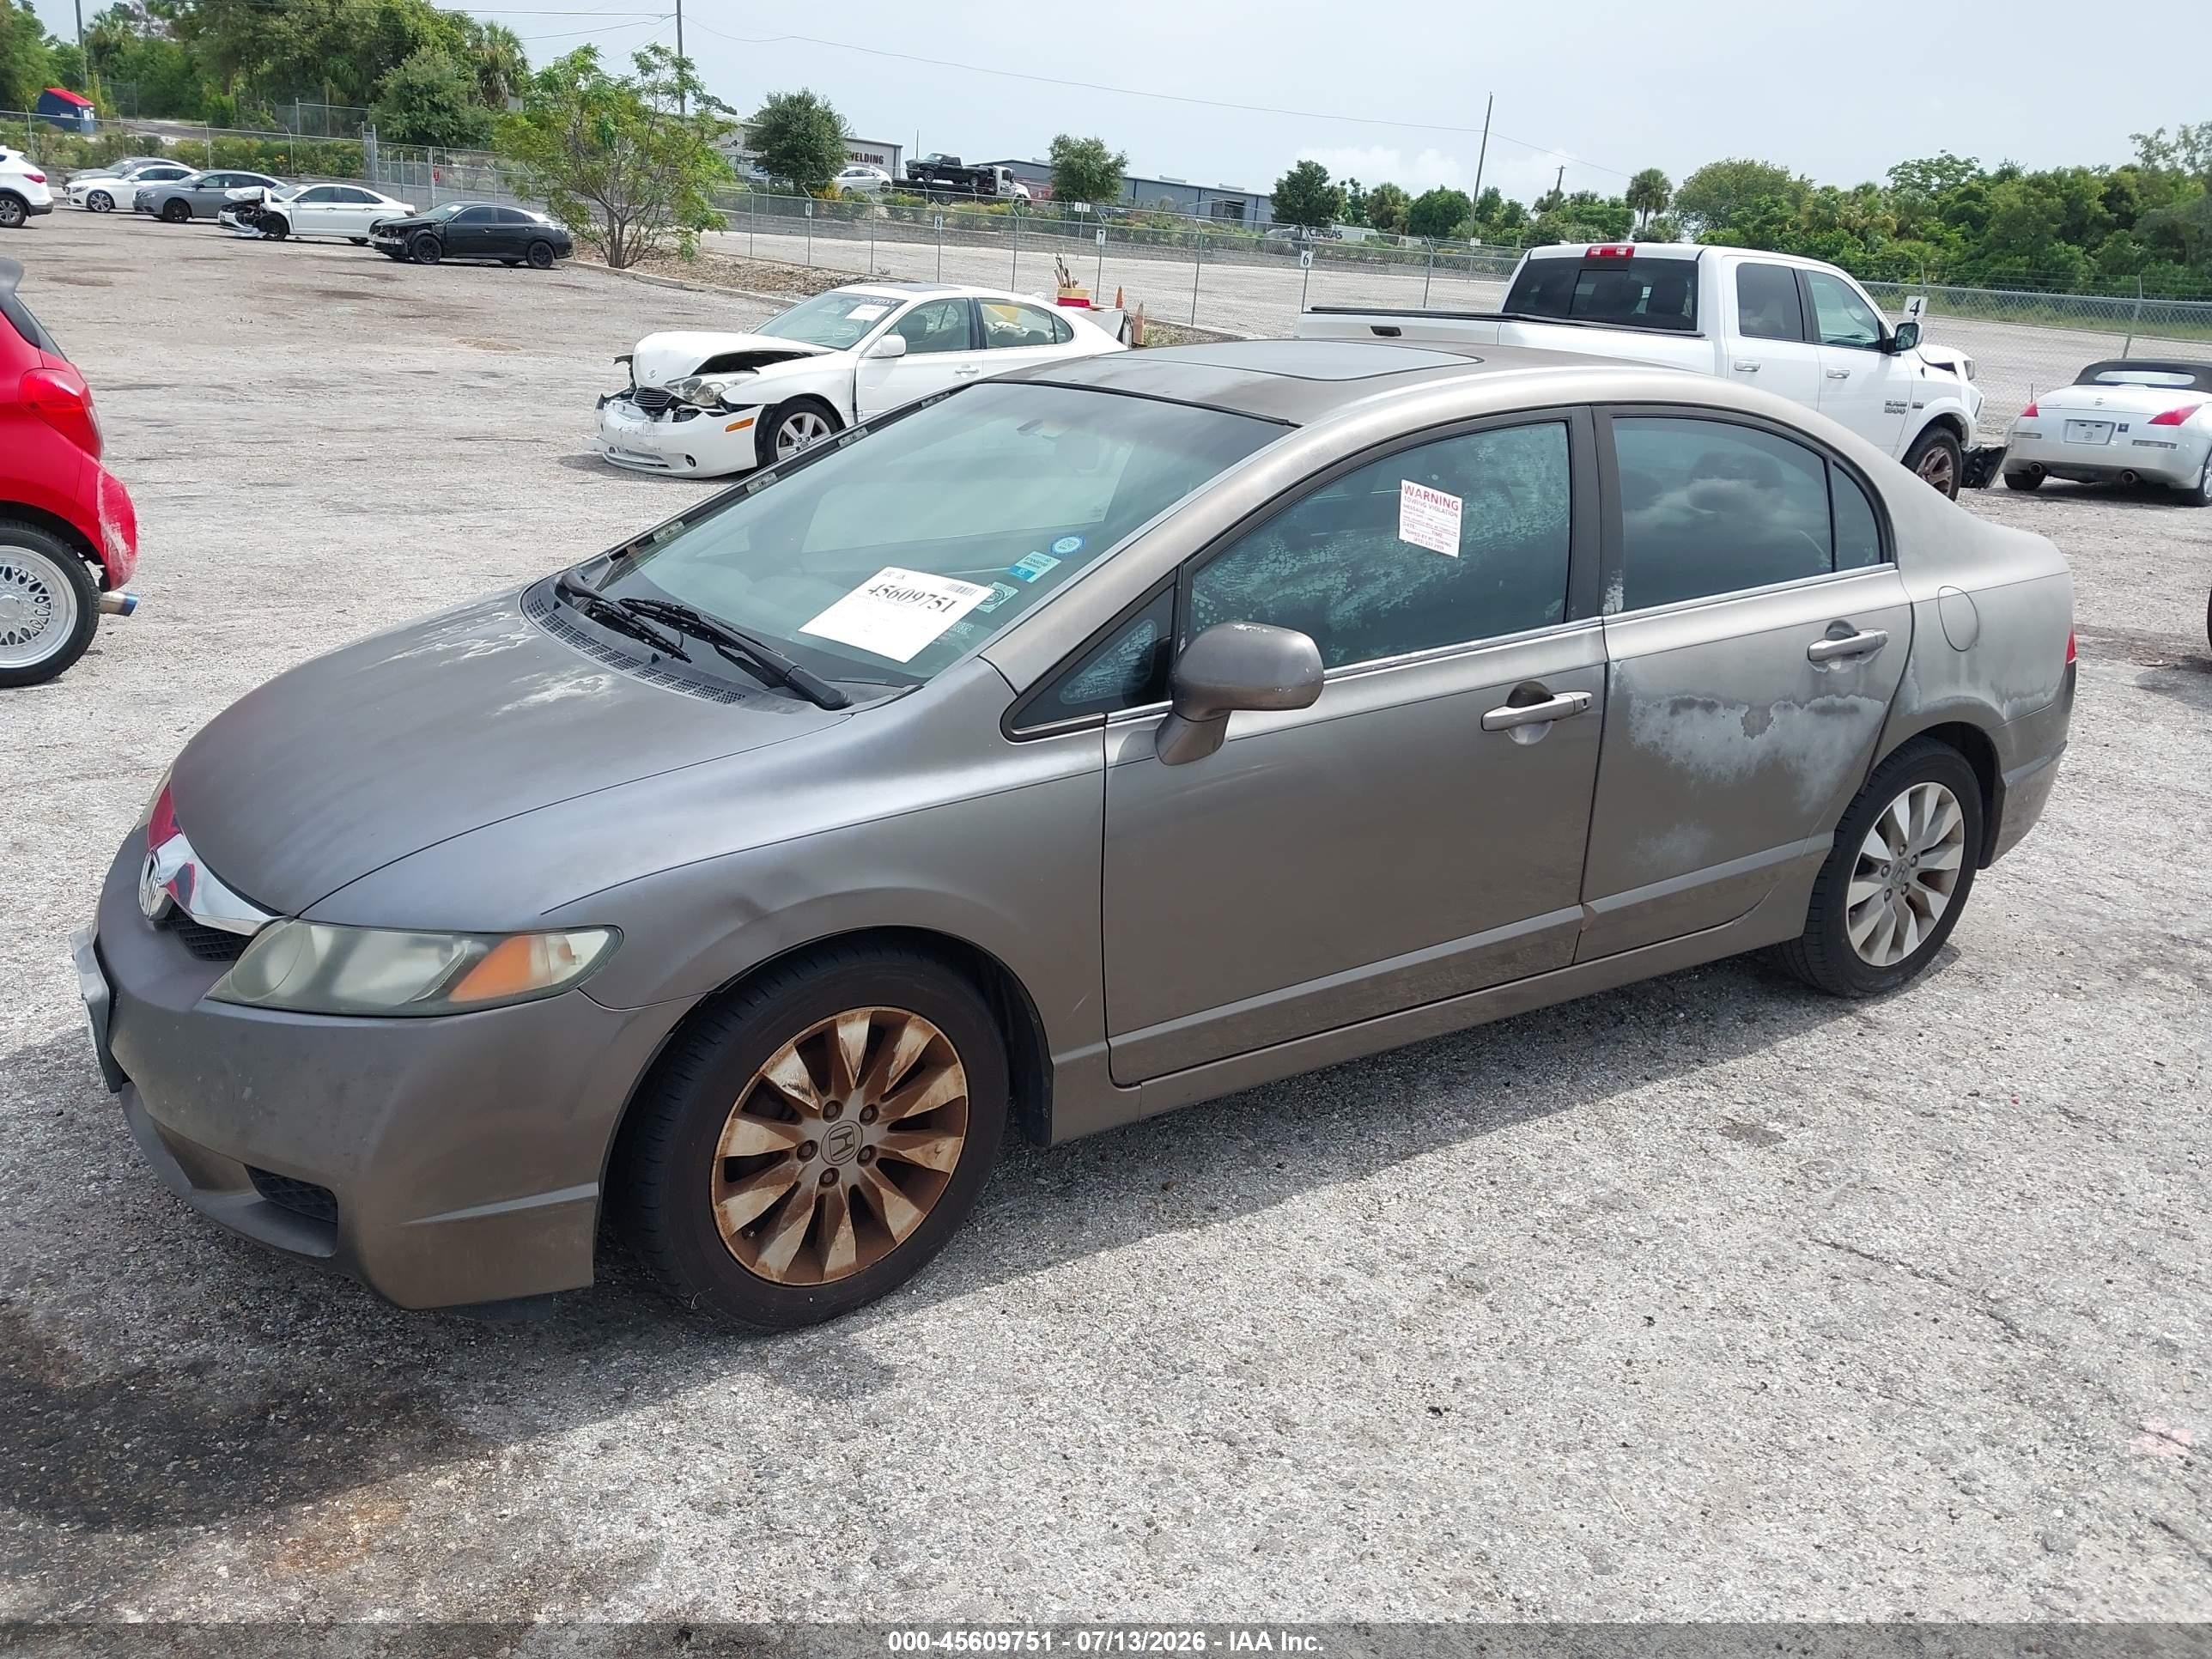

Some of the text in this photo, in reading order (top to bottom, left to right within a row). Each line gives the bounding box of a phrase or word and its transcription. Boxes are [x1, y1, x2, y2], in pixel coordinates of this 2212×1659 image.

[1098, 231, 1104, 244] 7
[1303, 253, 1310, 266] 6
[1909, 299, 1920, 317] 4
[1404, 483, 1459, 511] WARNING
[1428, 503, 1458, 519] VIOLATION
[868, 583, 957, 613] 45609751
